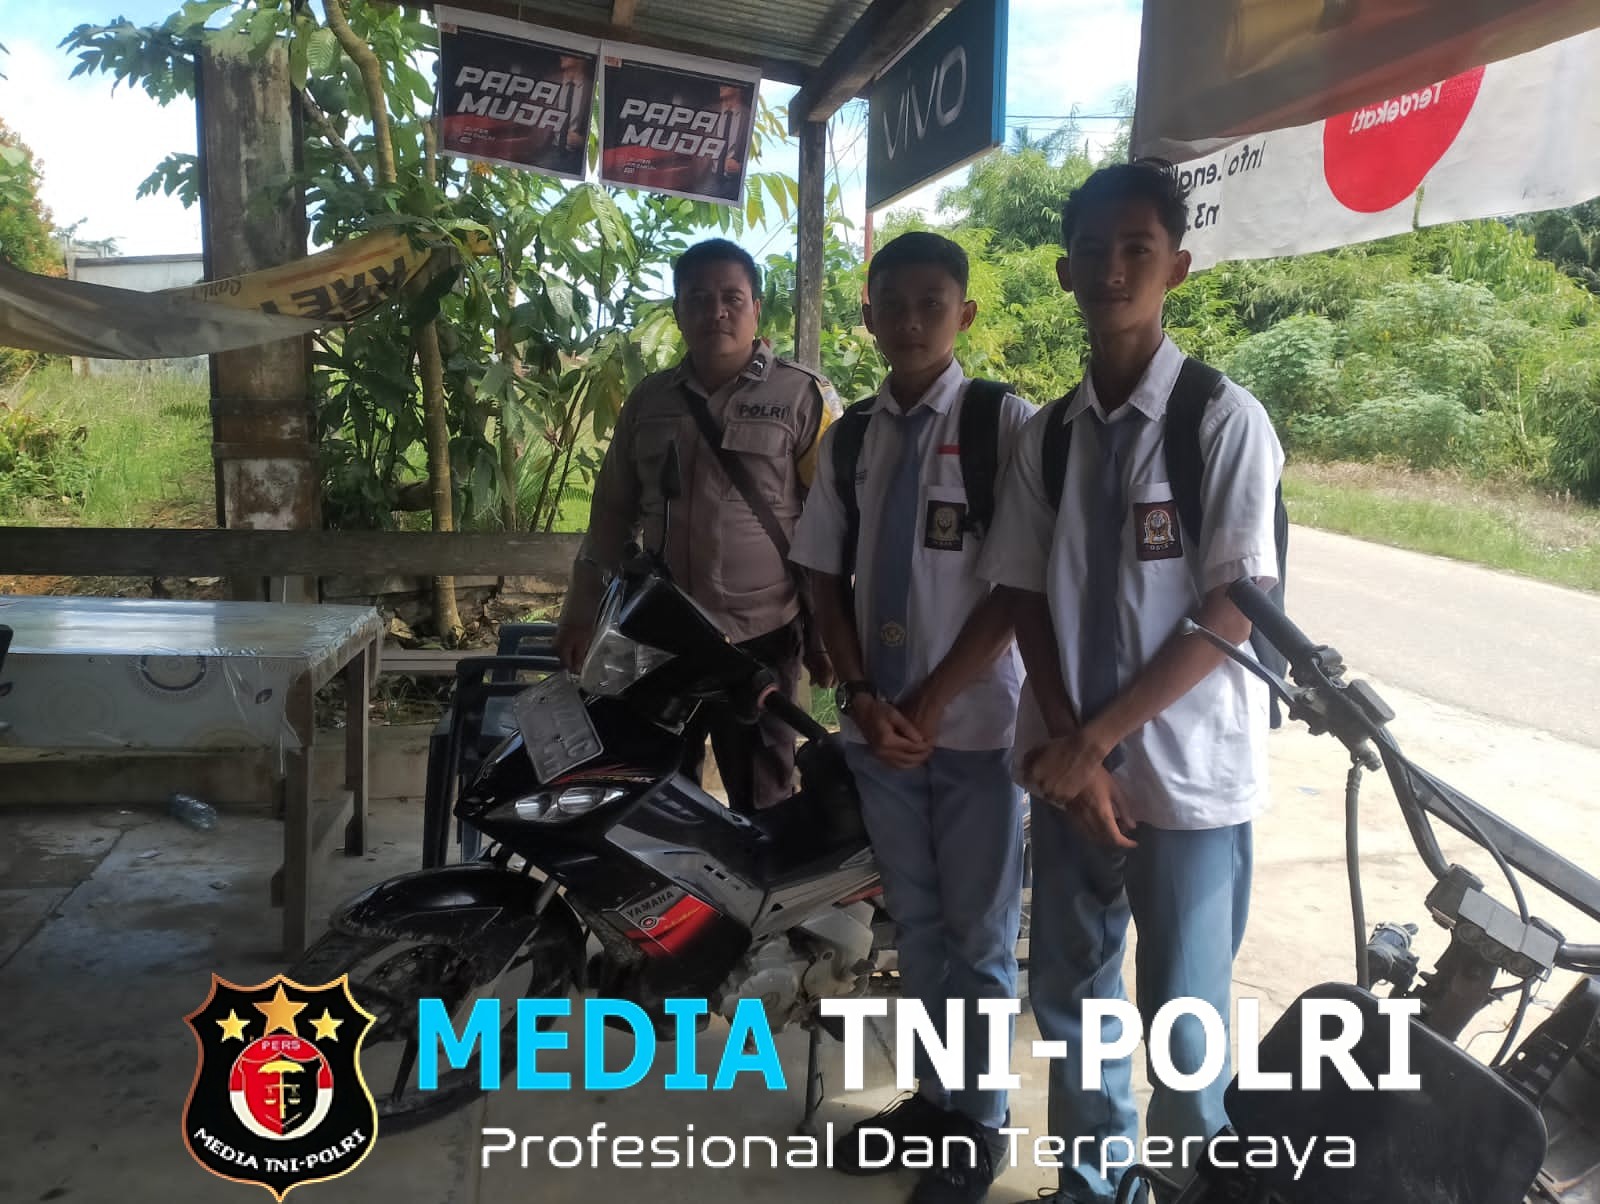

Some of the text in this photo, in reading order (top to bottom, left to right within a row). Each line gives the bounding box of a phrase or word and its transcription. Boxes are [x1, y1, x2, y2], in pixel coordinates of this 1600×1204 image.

[455, 66, 561, 105] PAPA
[457, 92, 569, 133] MUDA
[619, 98, 720, 134] PAPA
[621, 124, 727, 160] MUDA
[738, 403, 787, 419] POLRI
[627, 890, 675, 917] YAMAHA
